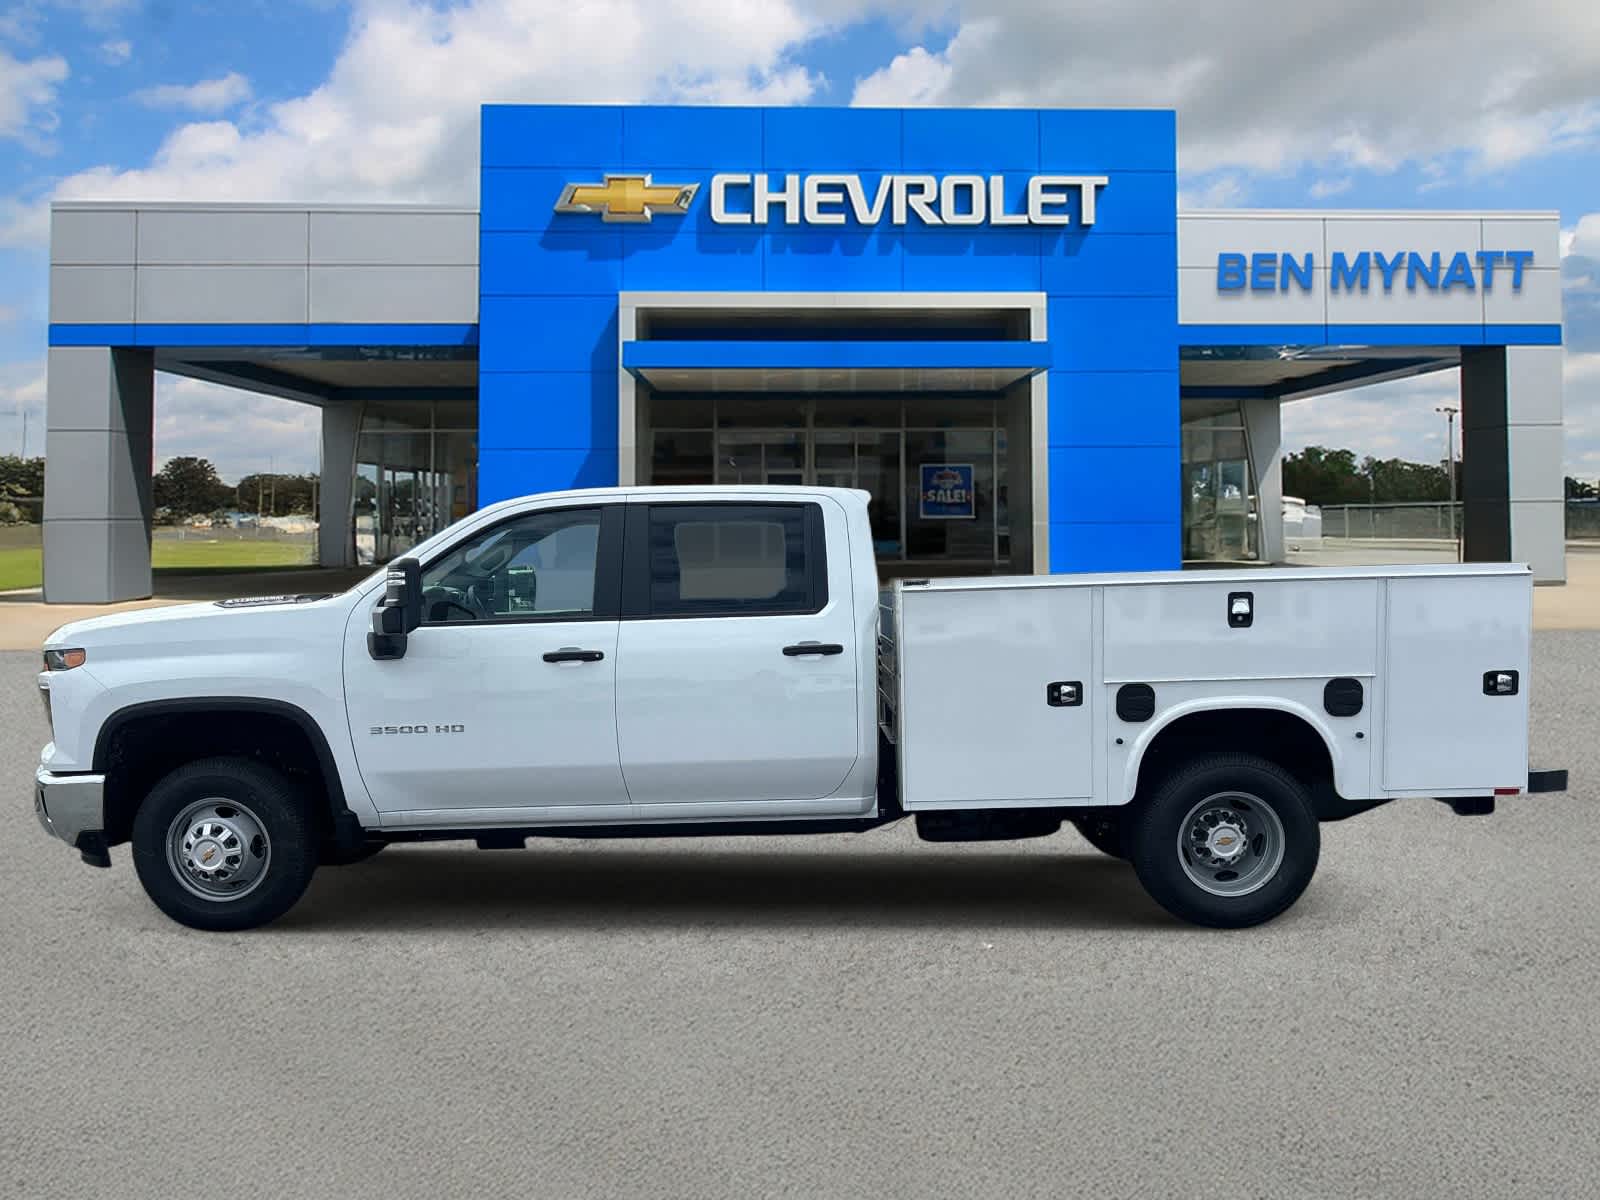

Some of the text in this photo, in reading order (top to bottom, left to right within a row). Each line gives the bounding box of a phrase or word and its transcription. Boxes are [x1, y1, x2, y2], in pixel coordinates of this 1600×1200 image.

[710, 173, 1109, 225] CHEVROLET
[1217, 250, 1534, 290] BEN MYNATT
[369, 724, 465, 735] 3500 HD
